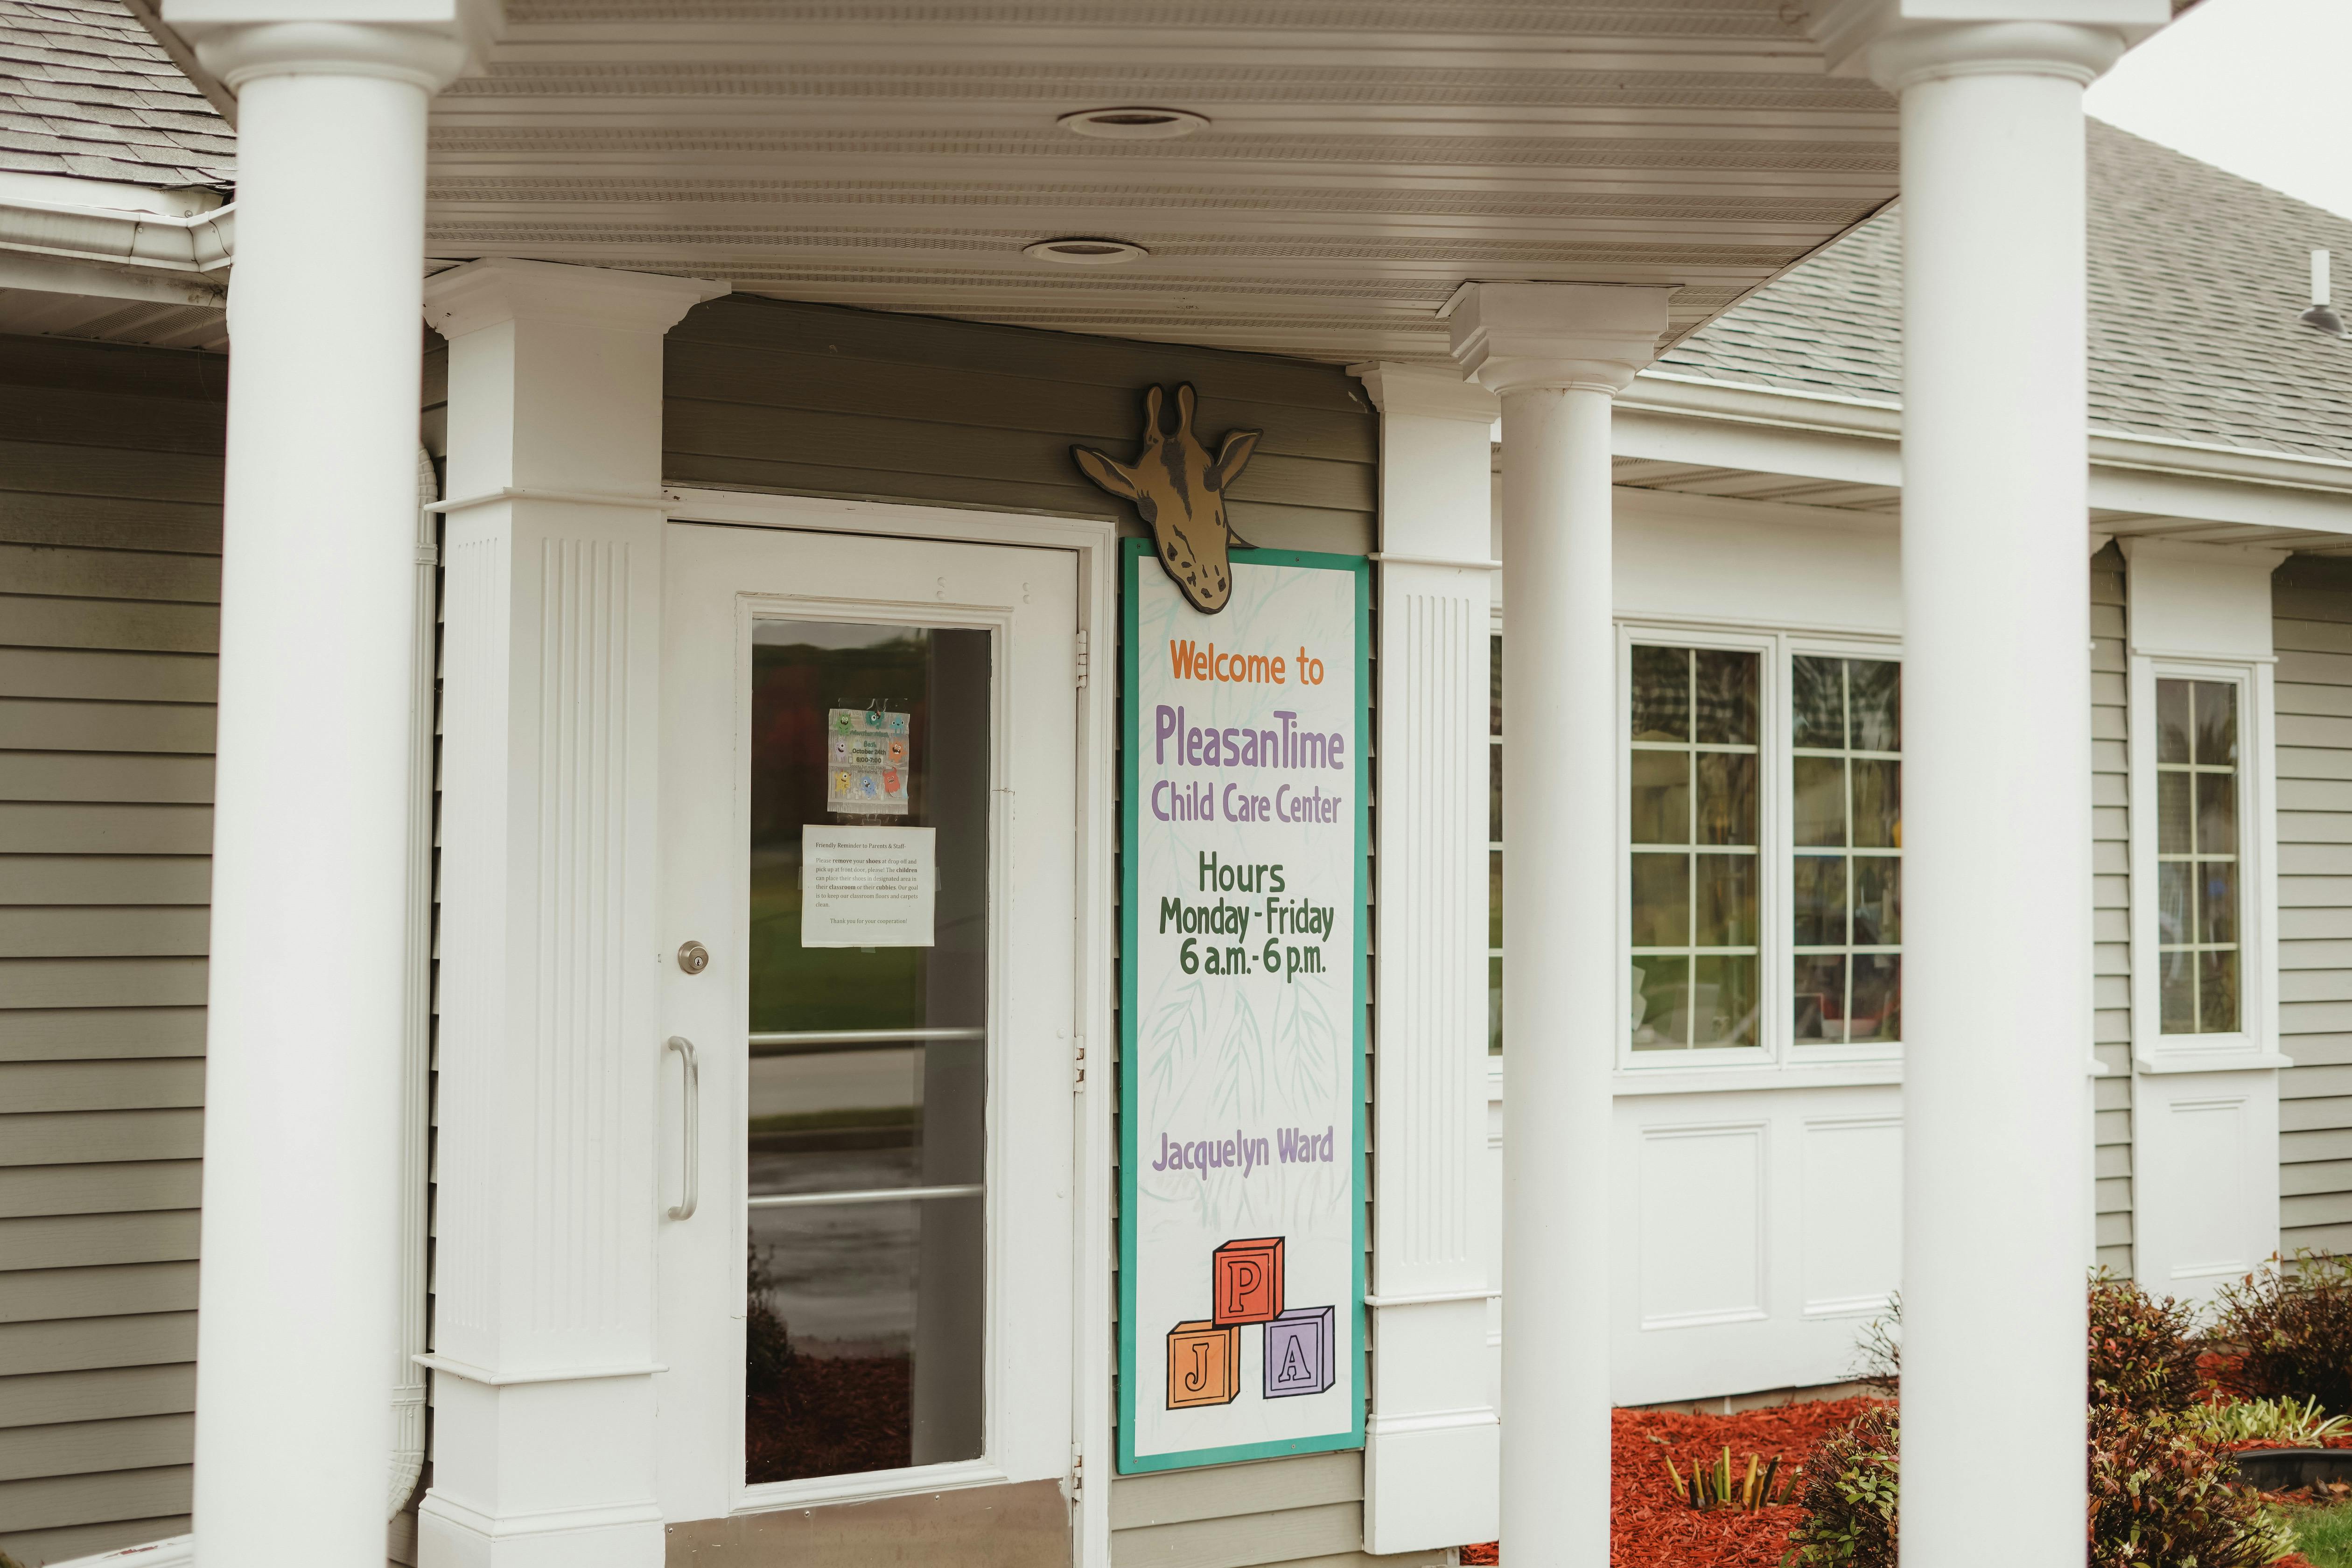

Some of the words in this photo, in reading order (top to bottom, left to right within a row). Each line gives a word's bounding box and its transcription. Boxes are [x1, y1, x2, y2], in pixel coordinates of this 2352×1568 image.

[1170, 639, 1285, 684] Welcome
[1296, 646, 1323, 685] to
[1155, 705, 1344, 770] PleasanTime
[1151, 780, 1214, 821] Child
[1222, 783, 1270, 822] Care
[1275, 784, 1341, 824] Center
[1199, 851, 1285, 893] Hours
[1180, 937, 1199, 973] 6
[1287, 943, 1326, 984] p.m.
[1152, 1129, 1269, 1180] Jacquelyn
[1277, 1126, 1333, 1164] Ward
[1228, 1260, 1261, 1313] P
[1184, 1343, 1210, 1392] J
[1278, 1335, 1311, 1382] A
